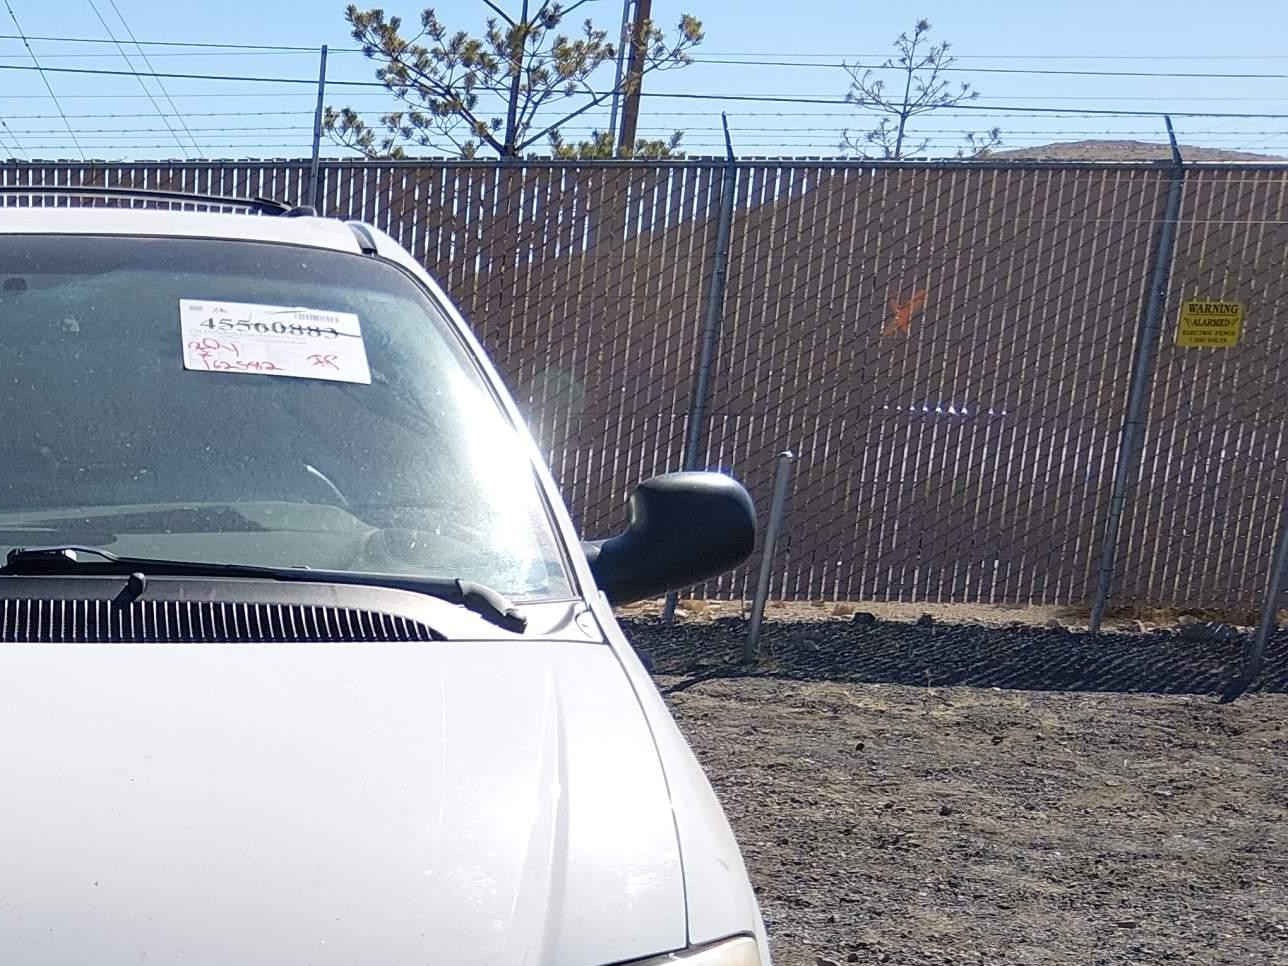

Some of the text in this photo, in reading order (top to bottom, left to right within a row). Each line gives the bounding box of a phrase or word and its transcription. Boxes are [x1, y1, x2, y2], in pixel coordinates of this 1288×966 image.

[1188, 303, 1239, 314] WARNING
[199, 316, 340, 340] 45560883
[1192, 318, 1231, 327] ALARMED
